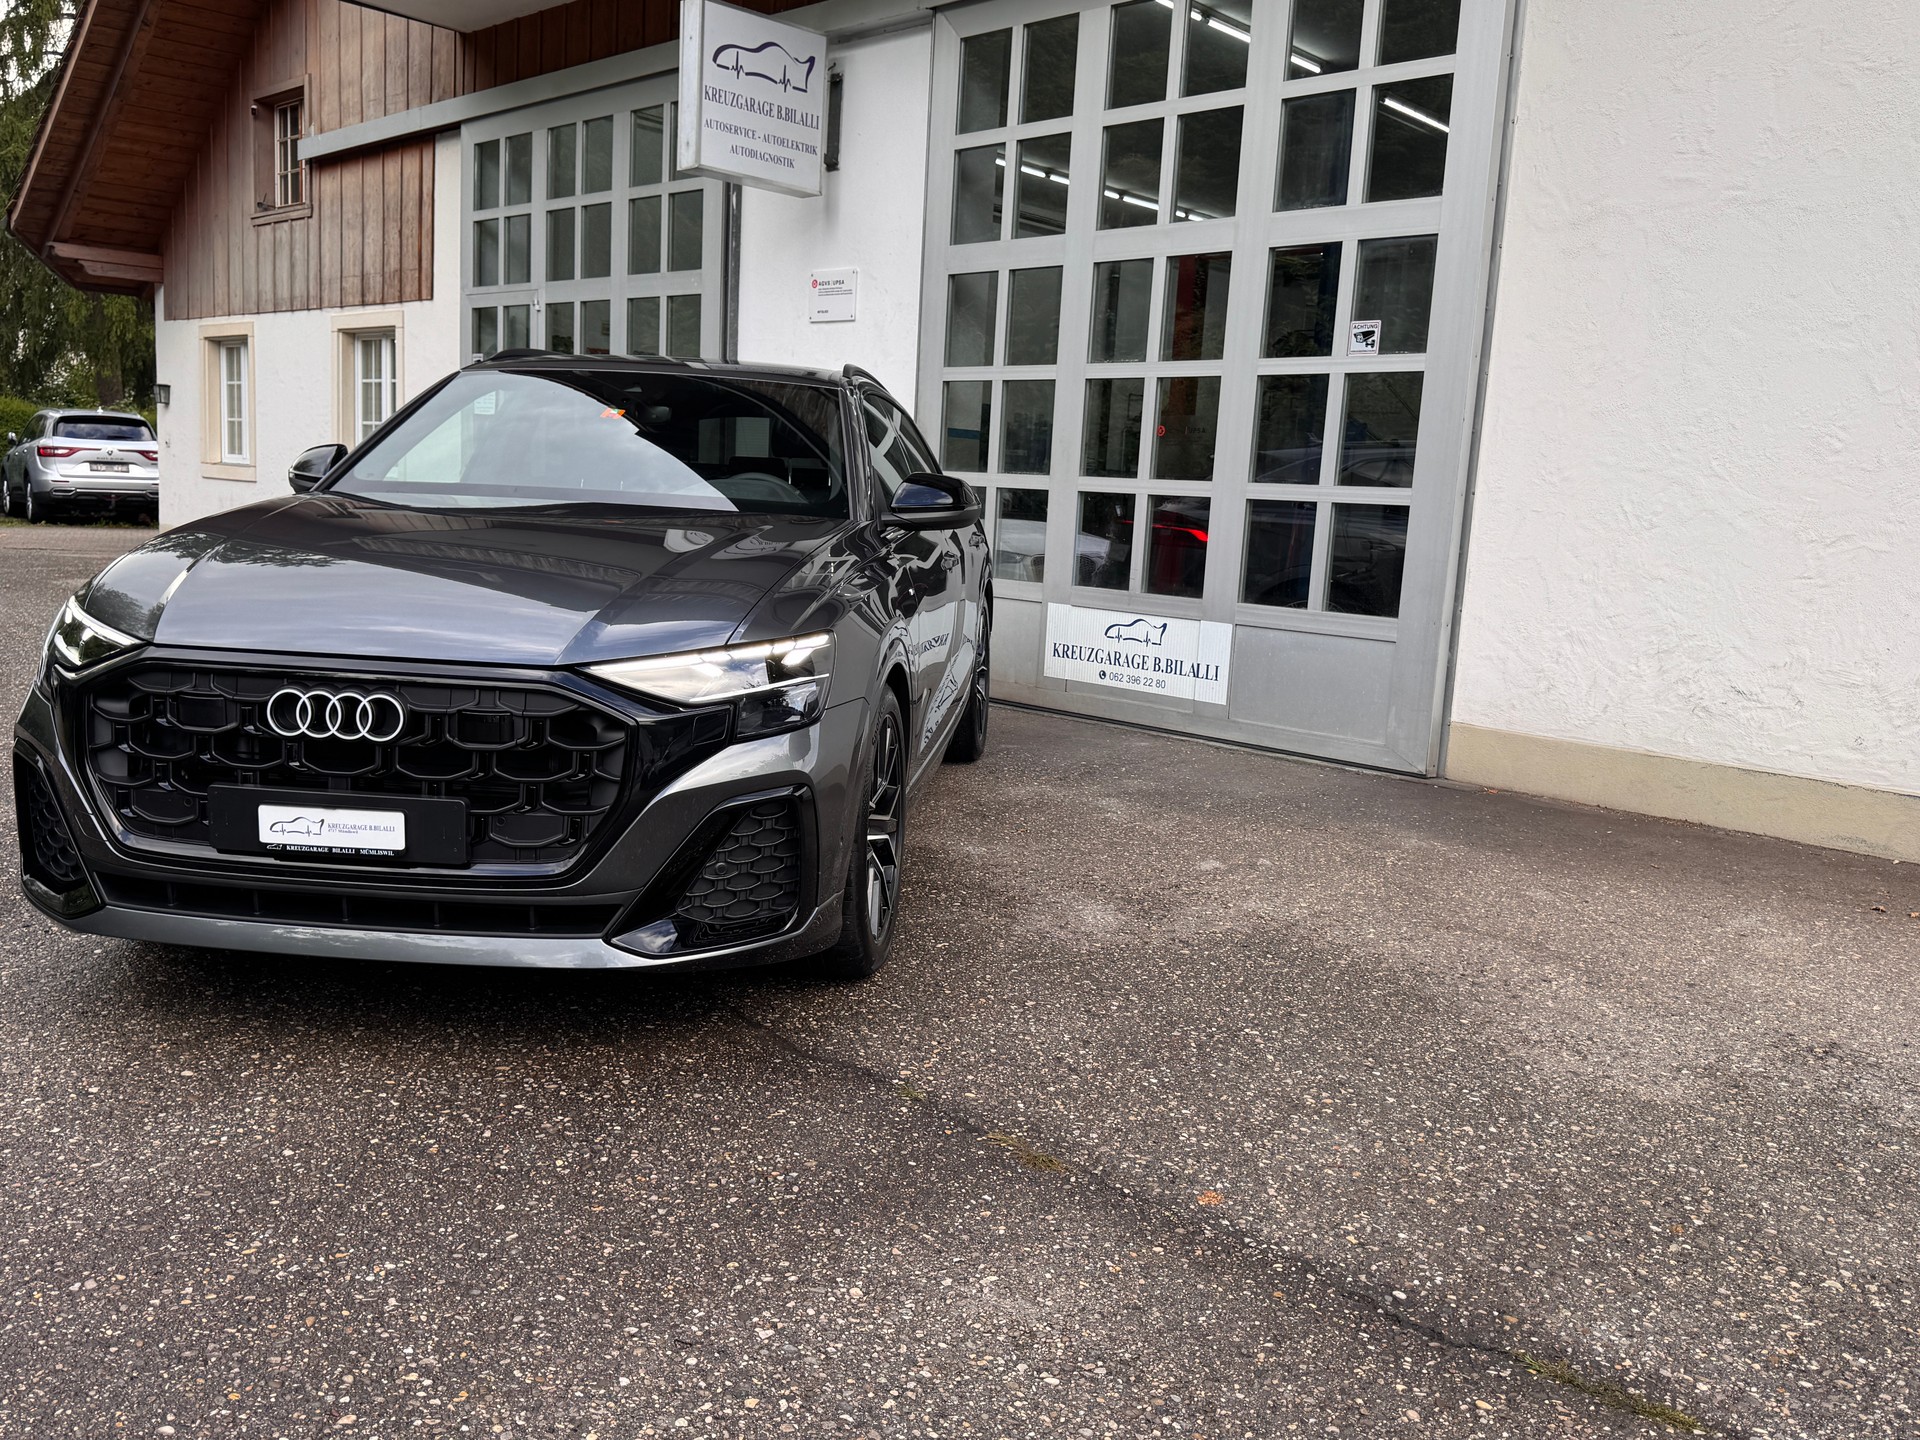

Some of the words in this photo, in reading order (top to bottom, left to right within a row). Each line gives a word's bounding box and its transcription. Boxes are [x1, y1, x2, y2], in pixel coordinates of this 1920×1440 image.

[704, 85, 775, 118] KREUZGARAGE
[776, 104, 819, 130] B.BILALLI
[704, 118, 757, 140] AUTOSERVICE
[762, 133, 818, 156] AUTOELEKTRIK
[729, 144, 795, 168] AUTODIAGNOSTIK
[1052, 642, 1149, 671] KREUZGARAGE
[1152, 656, 1220, 682] B.BILALLI
[1109, 671, 1124, 683] 062
[1126, 674, 1141, 685] 396
[1142, 676, 1154, 688] 22
[1155, 678, 1166, 690] 80
[327, 823, 368, 831] KREUZGARAGE
[286, 844, 329, 853] KREUZGARAGE
[331, 847, 356, 855] BILALLI
[359, 848, 395, 857] MÜMLISWIL
